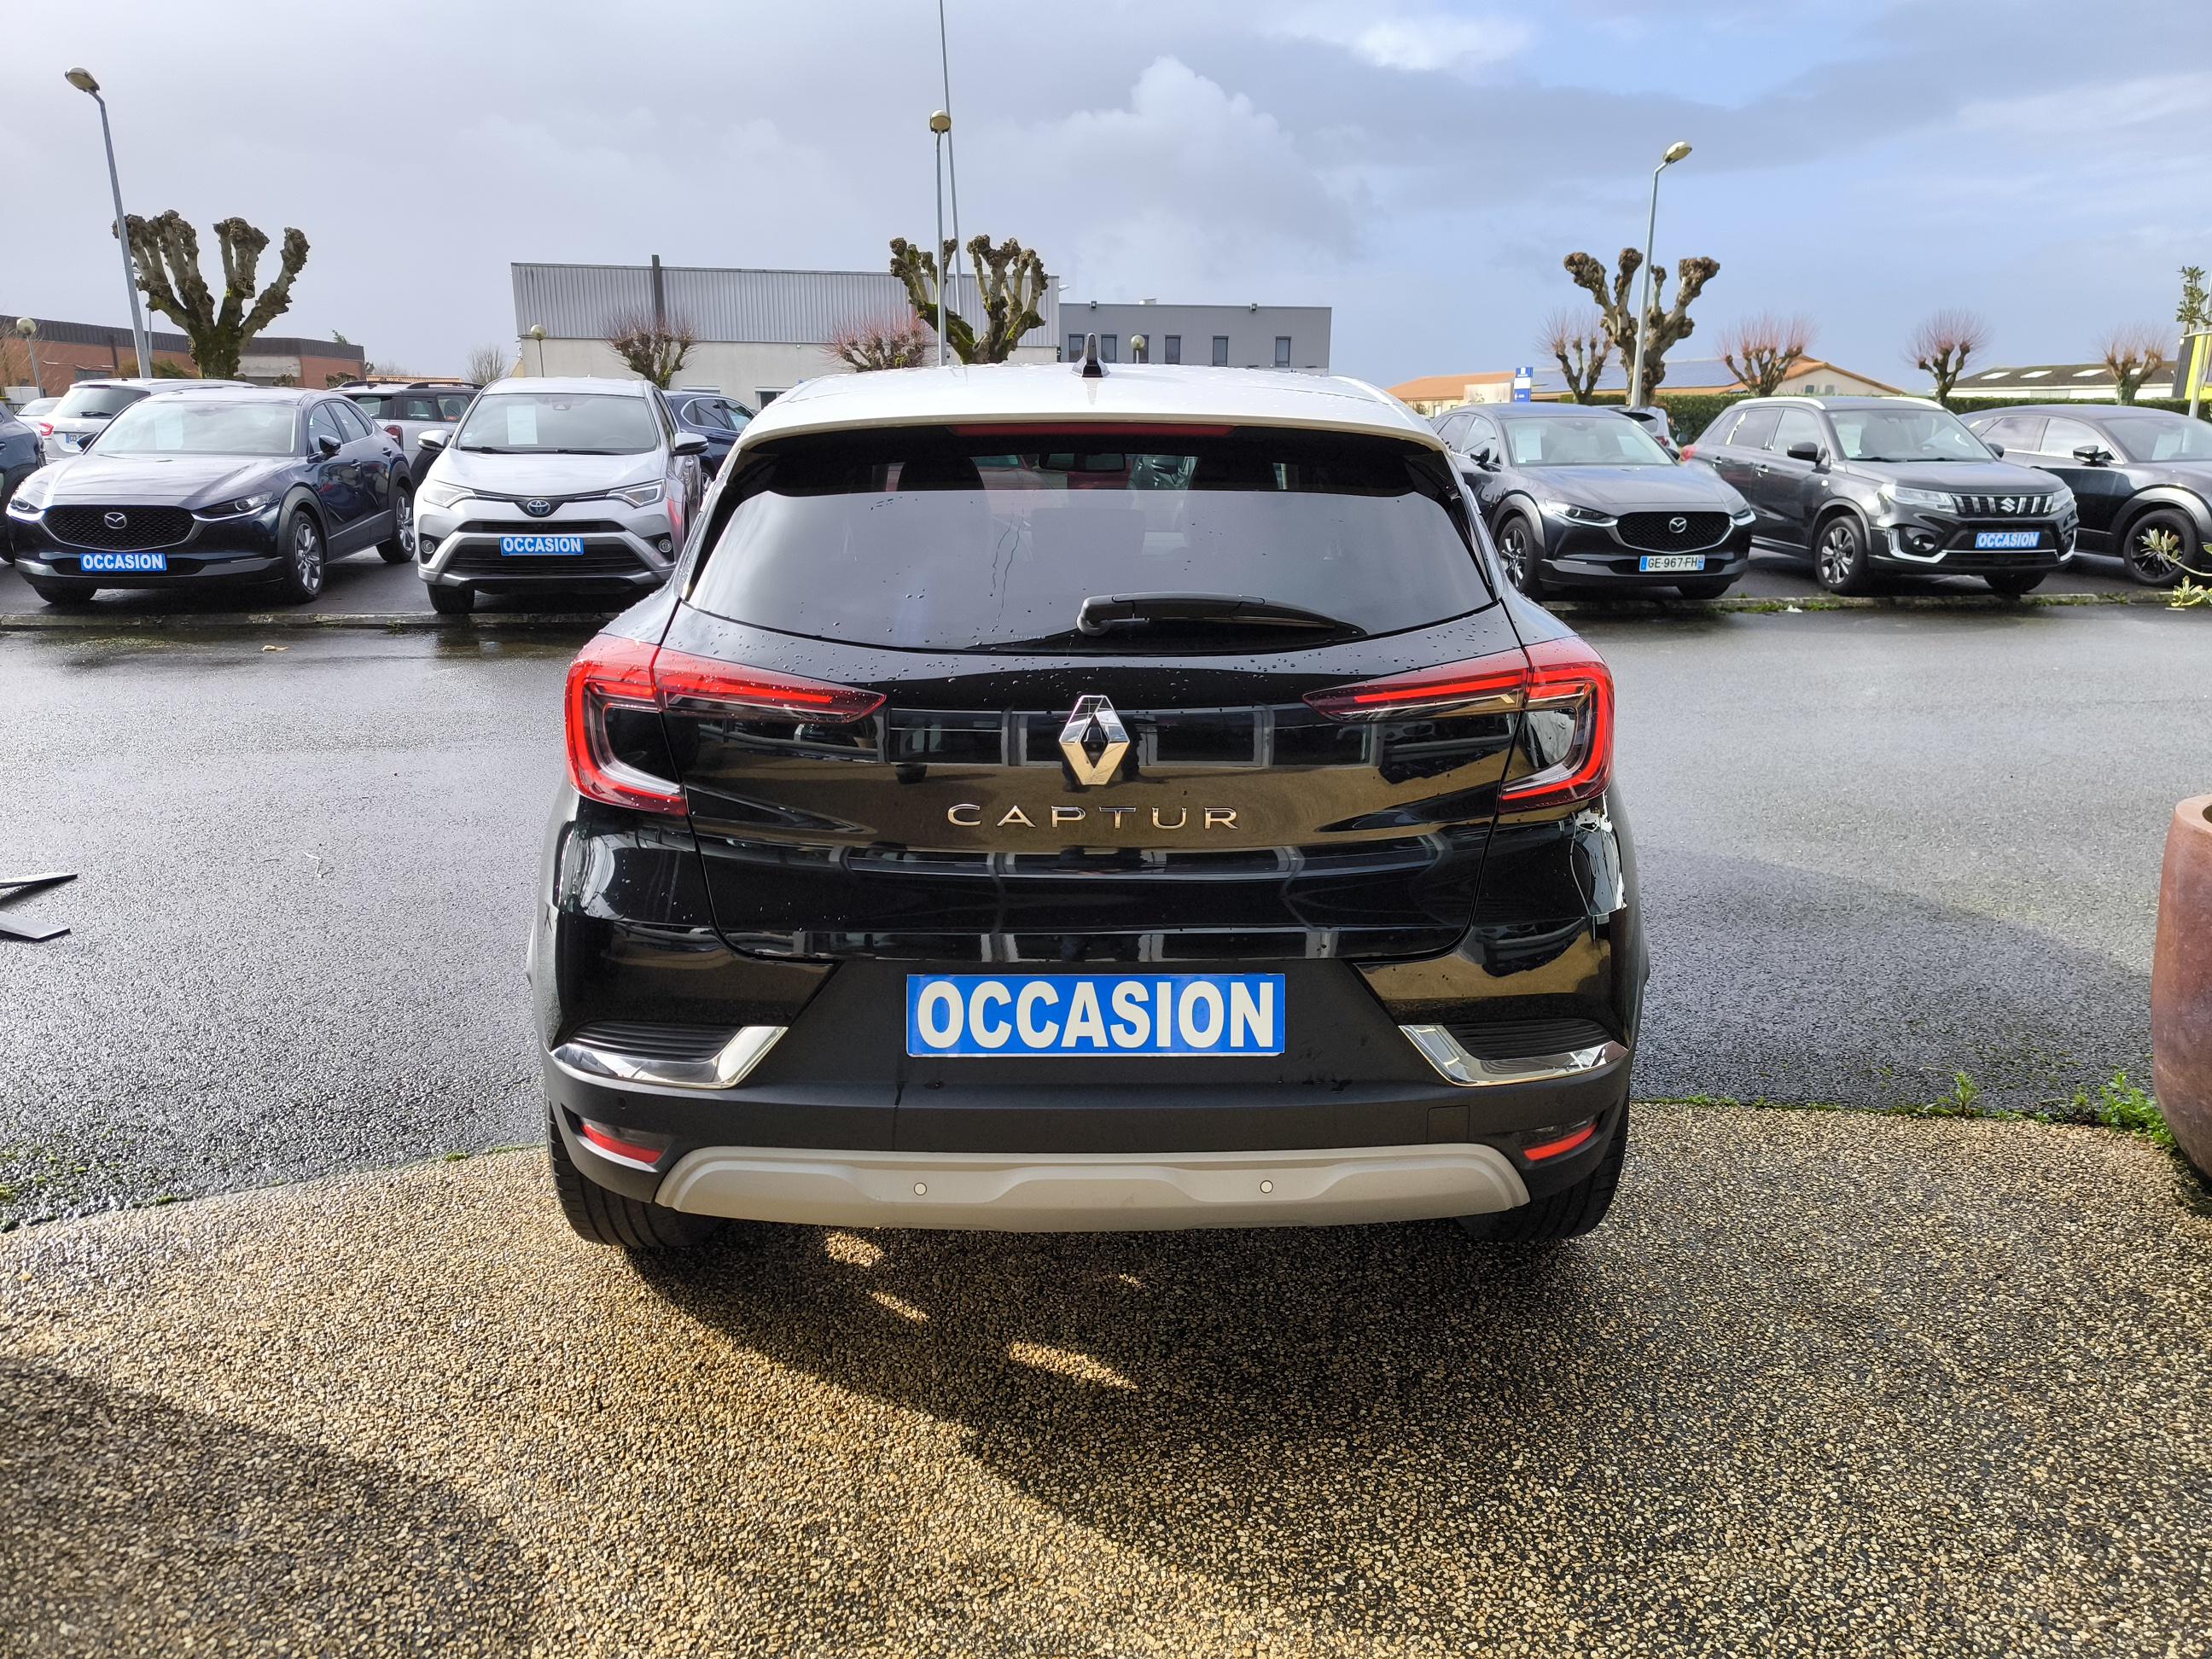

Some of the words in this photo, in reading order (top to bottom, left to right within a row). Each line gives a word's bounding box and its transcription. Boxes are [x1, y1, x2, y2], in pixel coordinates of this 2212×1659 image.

[503, 538, 581, 552] OCCASION
[1977, 533, 2038, 547] OCCASION
[83, 554, 163, 569] OCCASION
[946, 803, 1239, 830] CAPTUR
[917, 981, 1274, 1049] OCCASION
